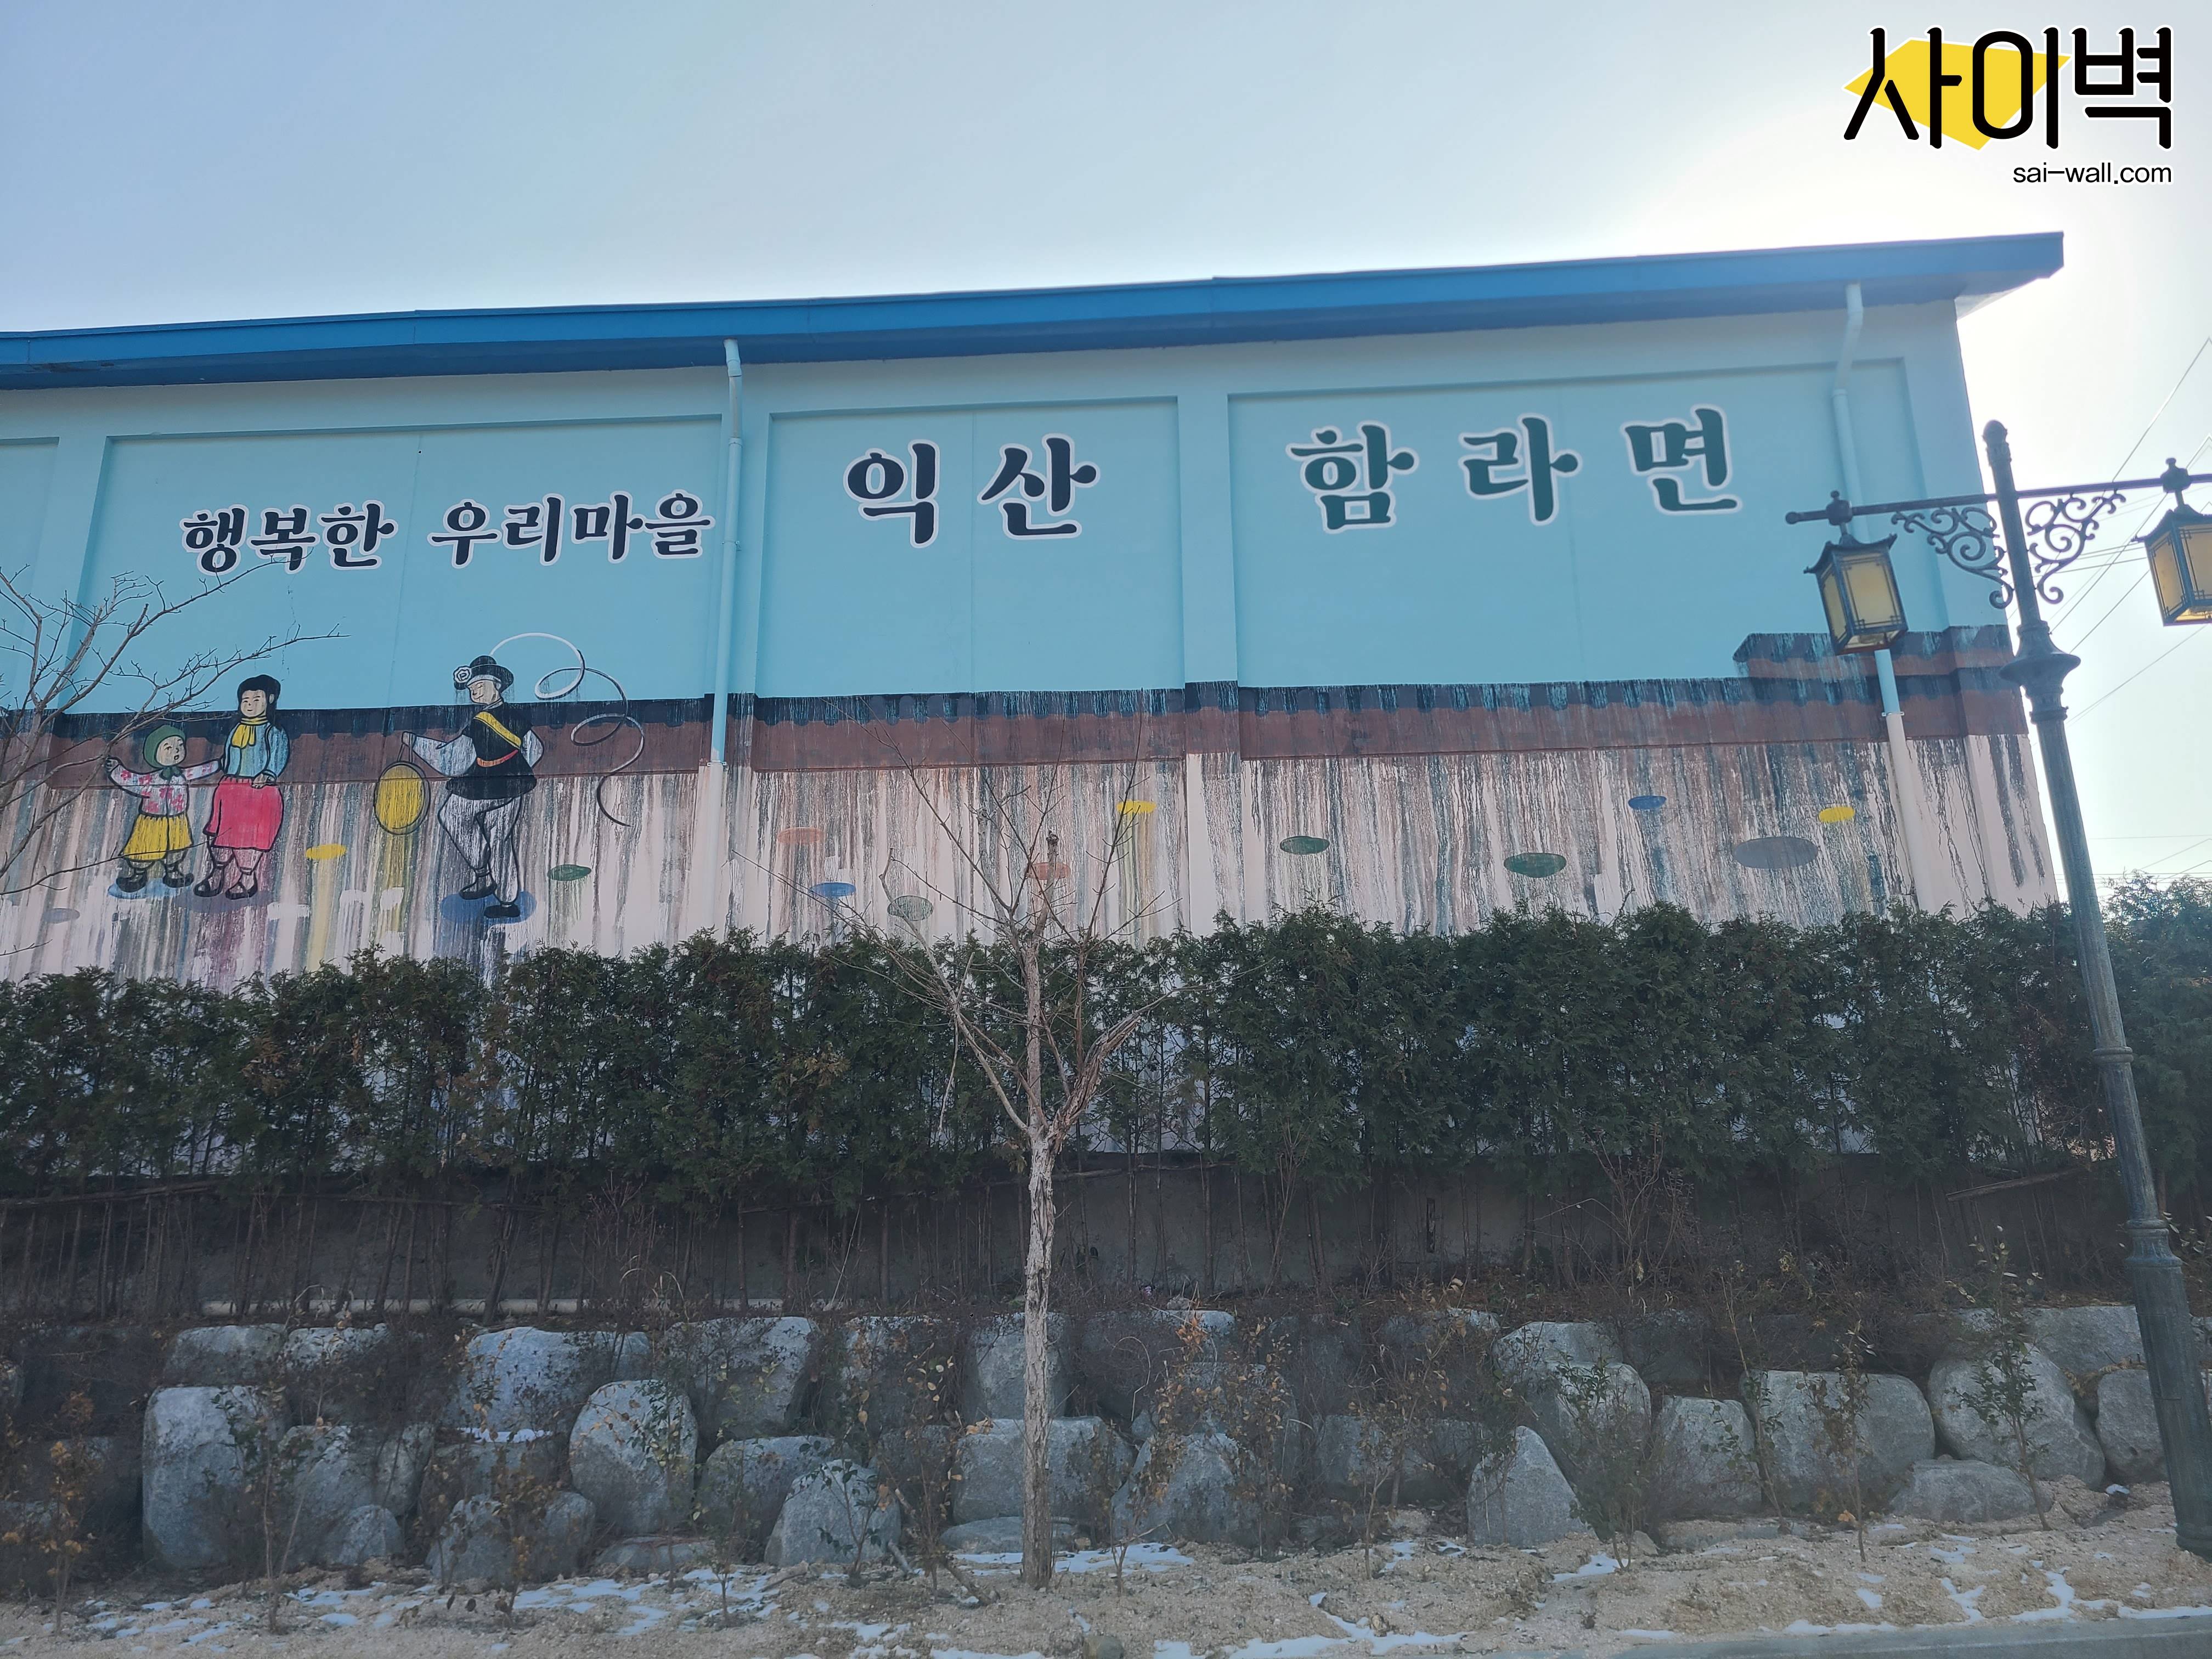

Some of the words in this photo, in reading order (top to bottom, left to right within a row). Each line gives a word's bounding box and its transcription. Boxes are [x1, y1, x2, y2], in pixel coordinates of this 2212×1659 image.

[182, 500, 395, 574] 행복한
[431, 492, 713, 567] 우리마을
[846, 436, 1098, 545] 익산
[1289, 406, 1739, 531] 함라면
